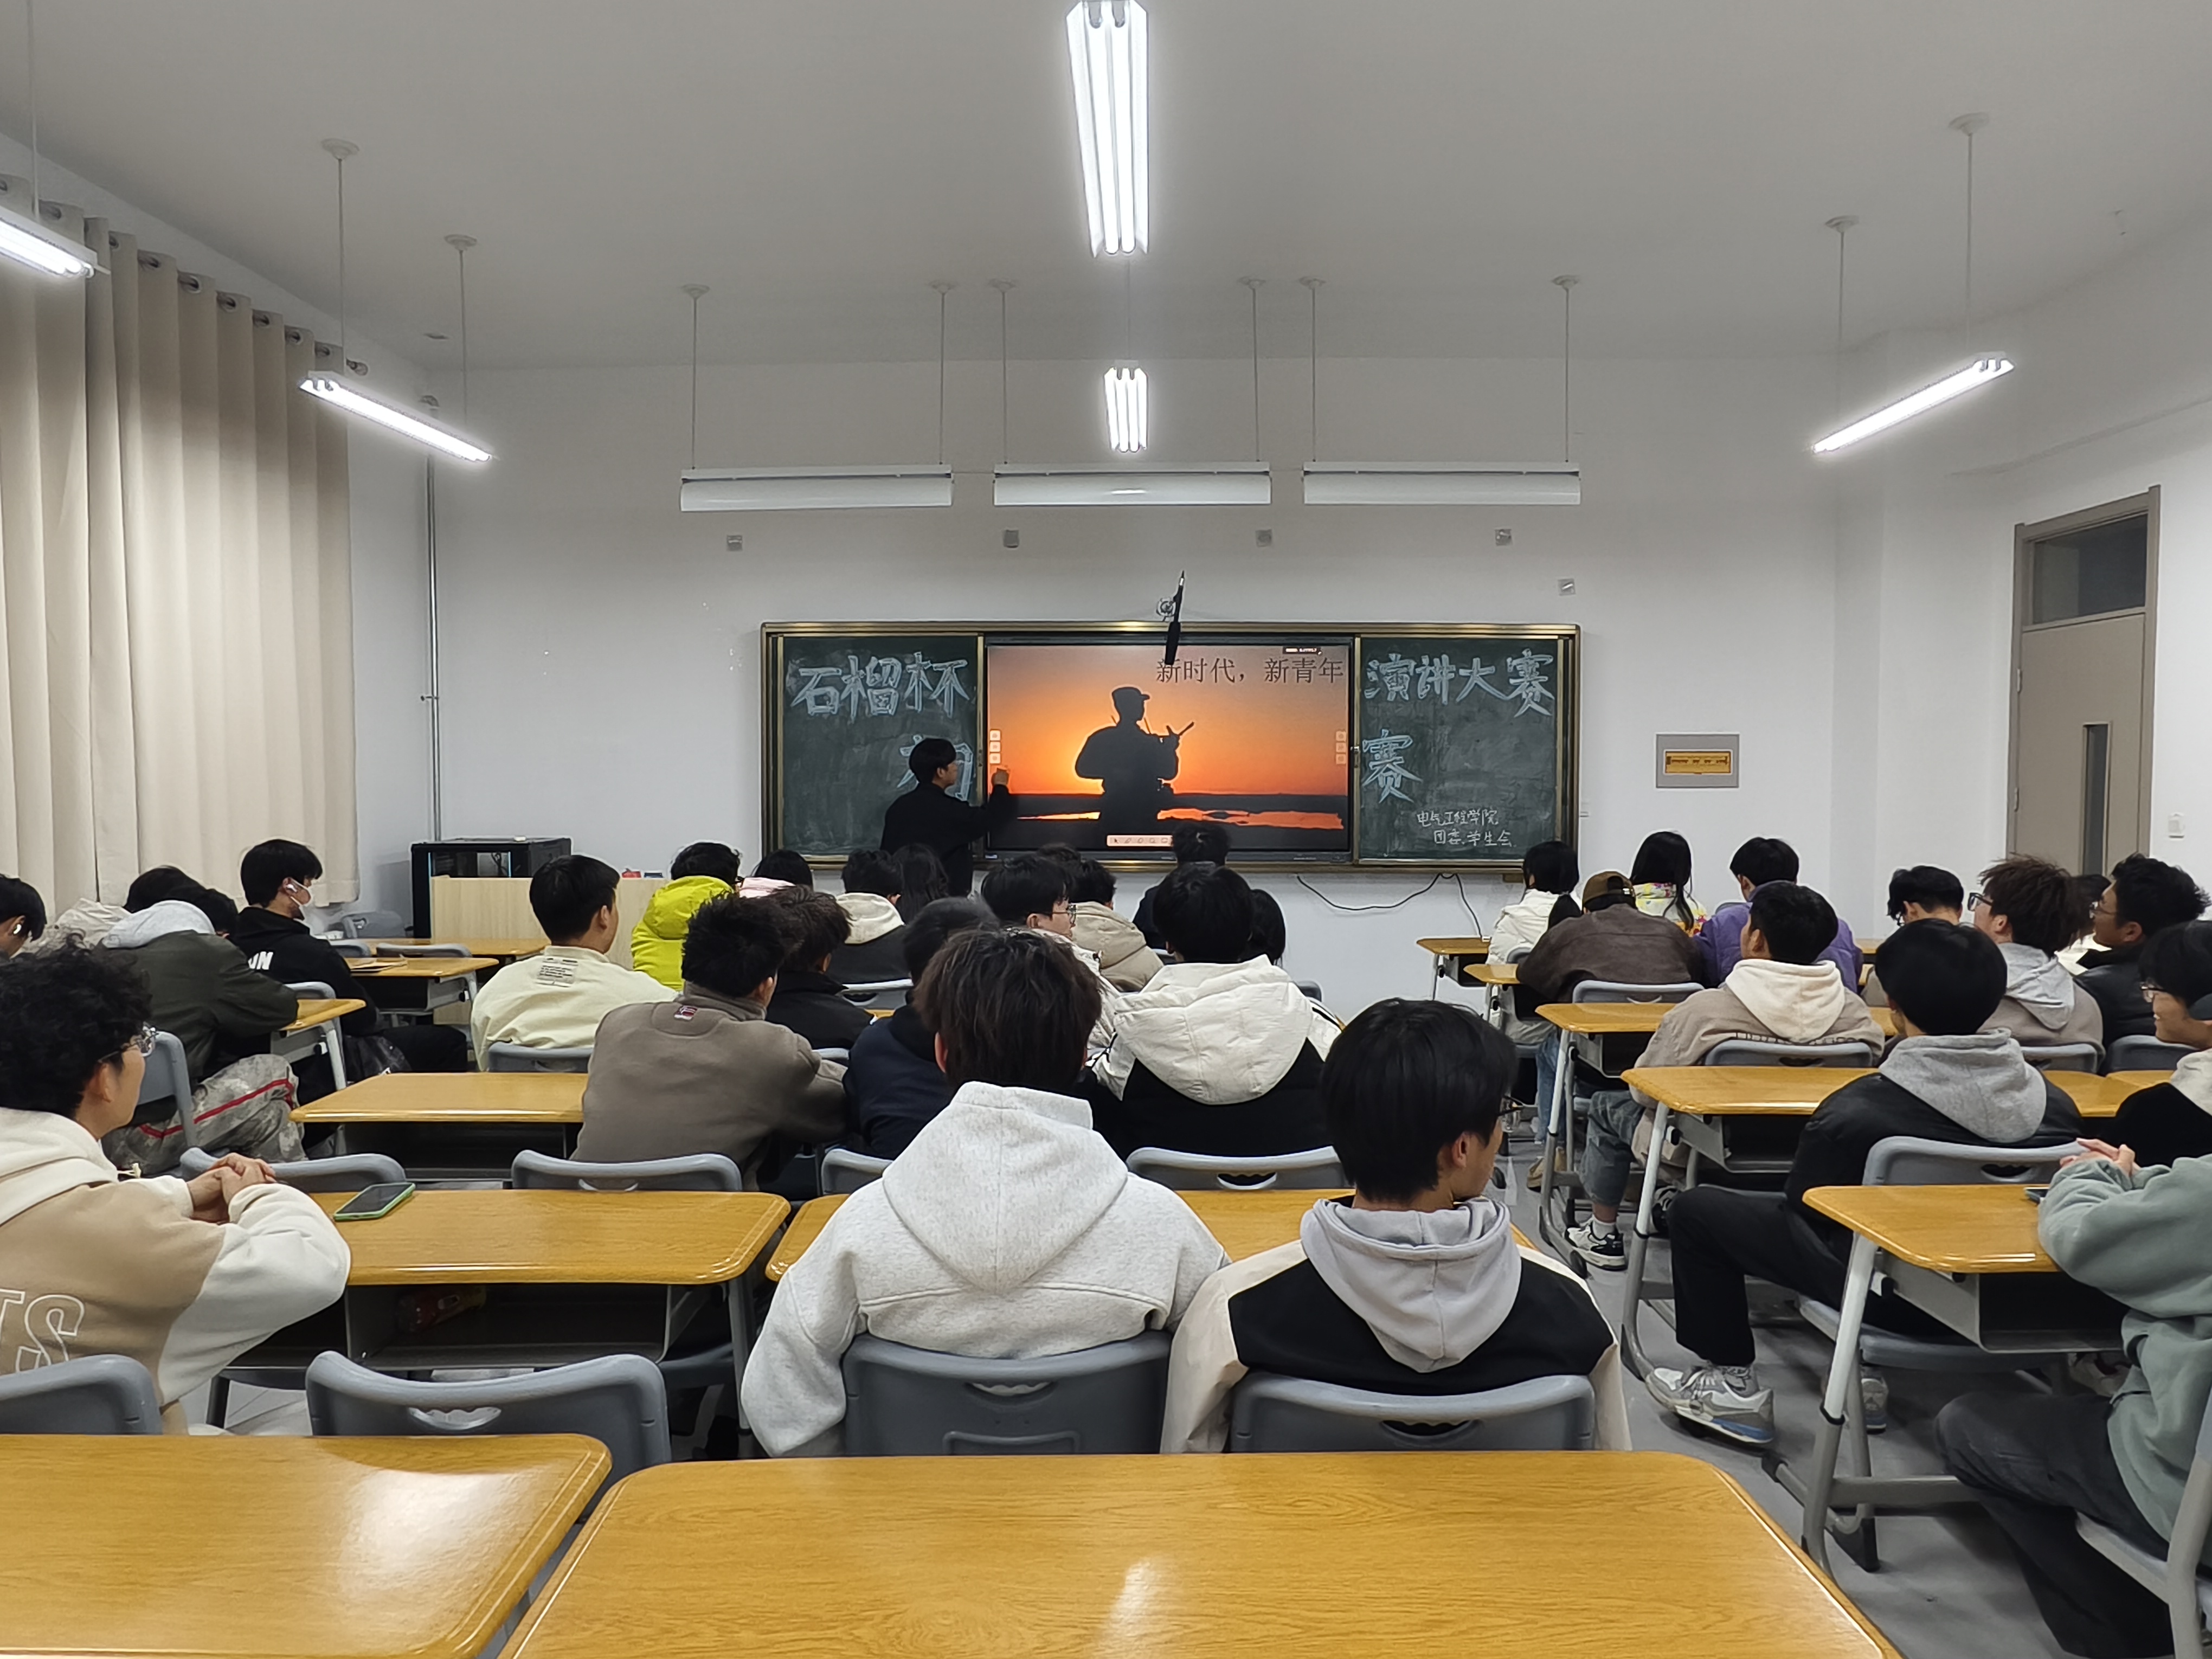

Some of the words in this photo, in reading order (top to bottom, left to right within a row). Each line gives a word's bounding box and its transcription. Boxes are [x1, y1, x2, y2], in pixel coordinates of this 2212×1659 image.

[791, 652, 969, 723] 石榴杯
[1364, 648, 1555, 718] 演讲大赛
[1361, 729, 1423, 803] 赛
[1417, 808, 1499, 827] 电气工程学院
